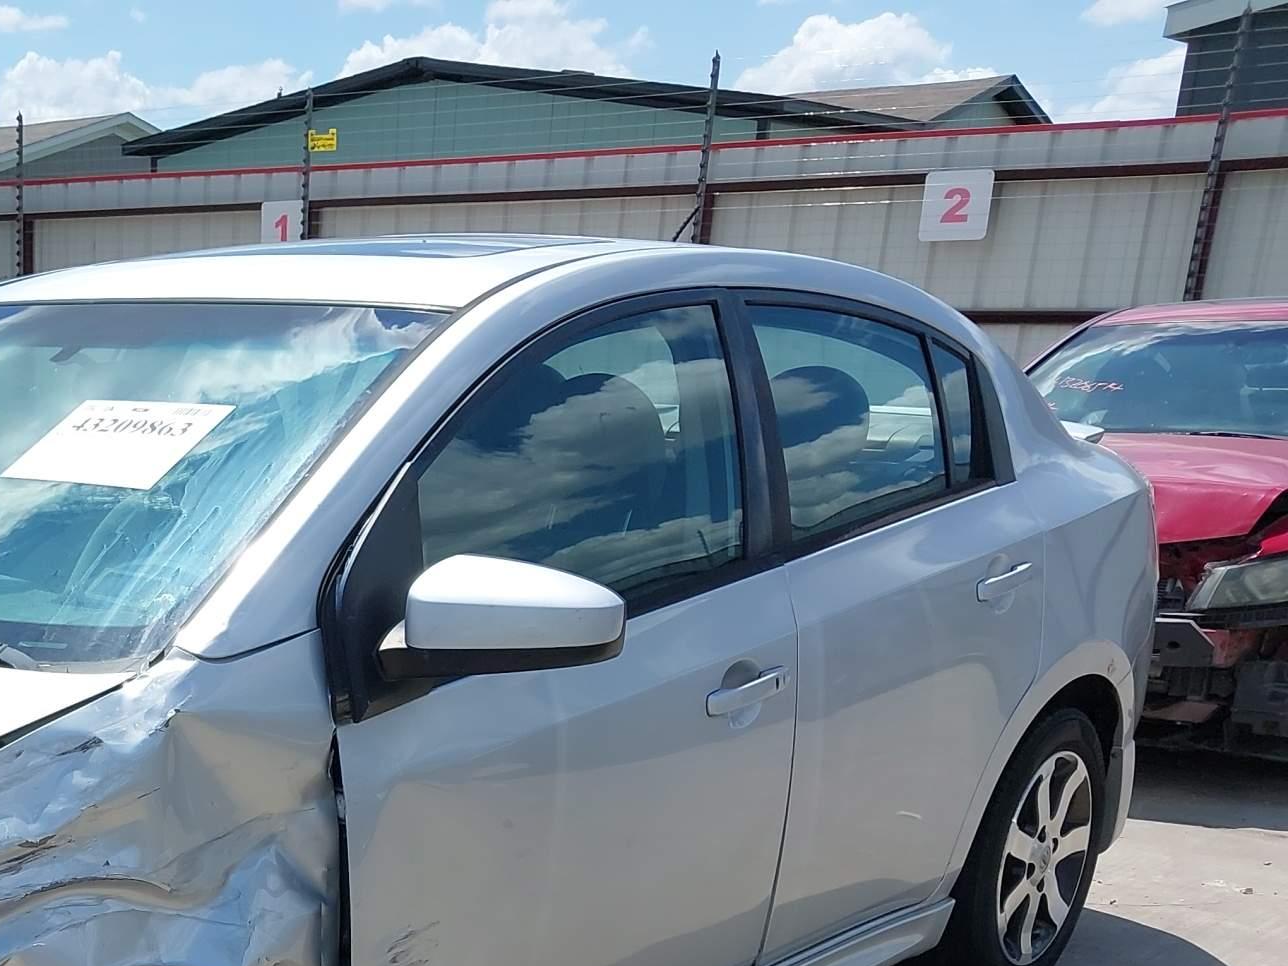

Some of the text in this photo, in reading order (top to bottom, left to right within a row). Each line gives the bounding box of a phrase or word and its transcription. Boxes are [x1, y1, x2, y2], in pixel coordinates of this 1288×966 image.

[940, 187, 971, 224] 2
[274, 214, 288, 242] 1
[72, 417, 192, 436] 43209863
